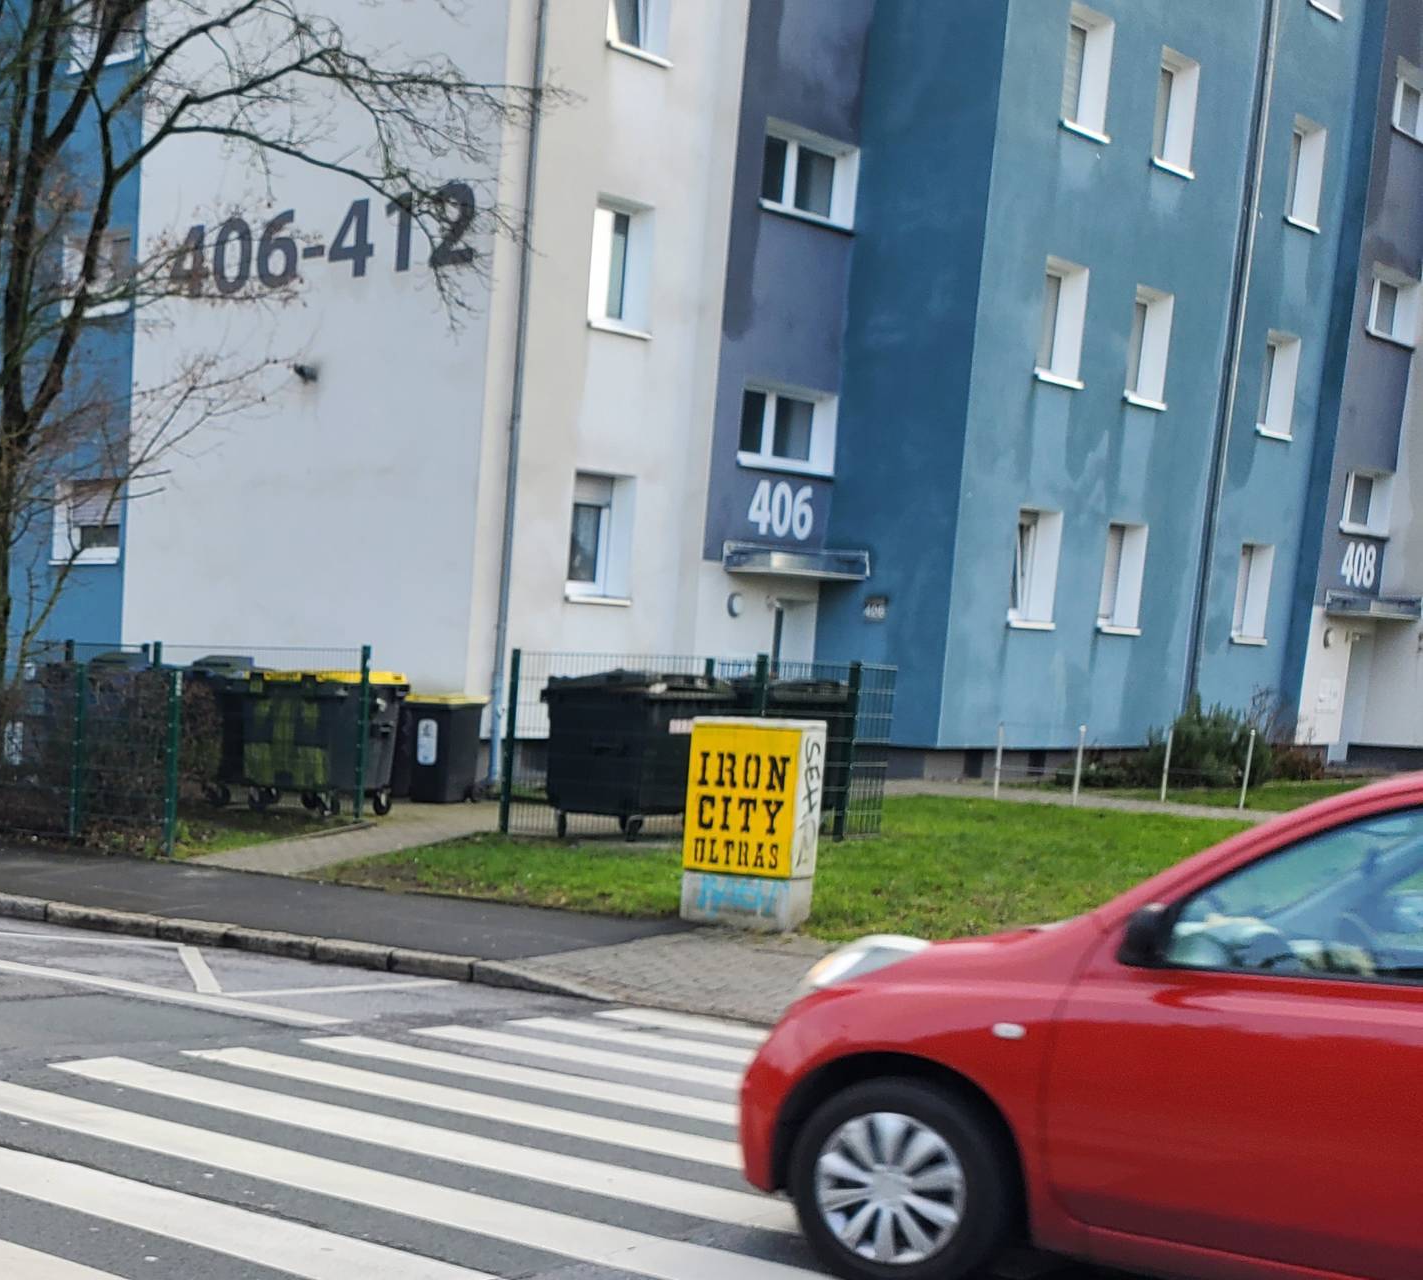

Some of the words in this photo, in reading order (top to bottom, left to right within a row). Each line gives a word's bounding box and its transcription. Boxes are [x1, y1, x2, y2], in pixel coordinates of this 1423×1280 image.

[169, 182, 476, 298] 406-412
[747, 479, 814, 541] 406
[1340, 541, 1377, 589] 408
[698, 751, 791, 793] IRON
[698, 794, 785, 835] CITY
[693, 836, 779, 870] ULTRAS
